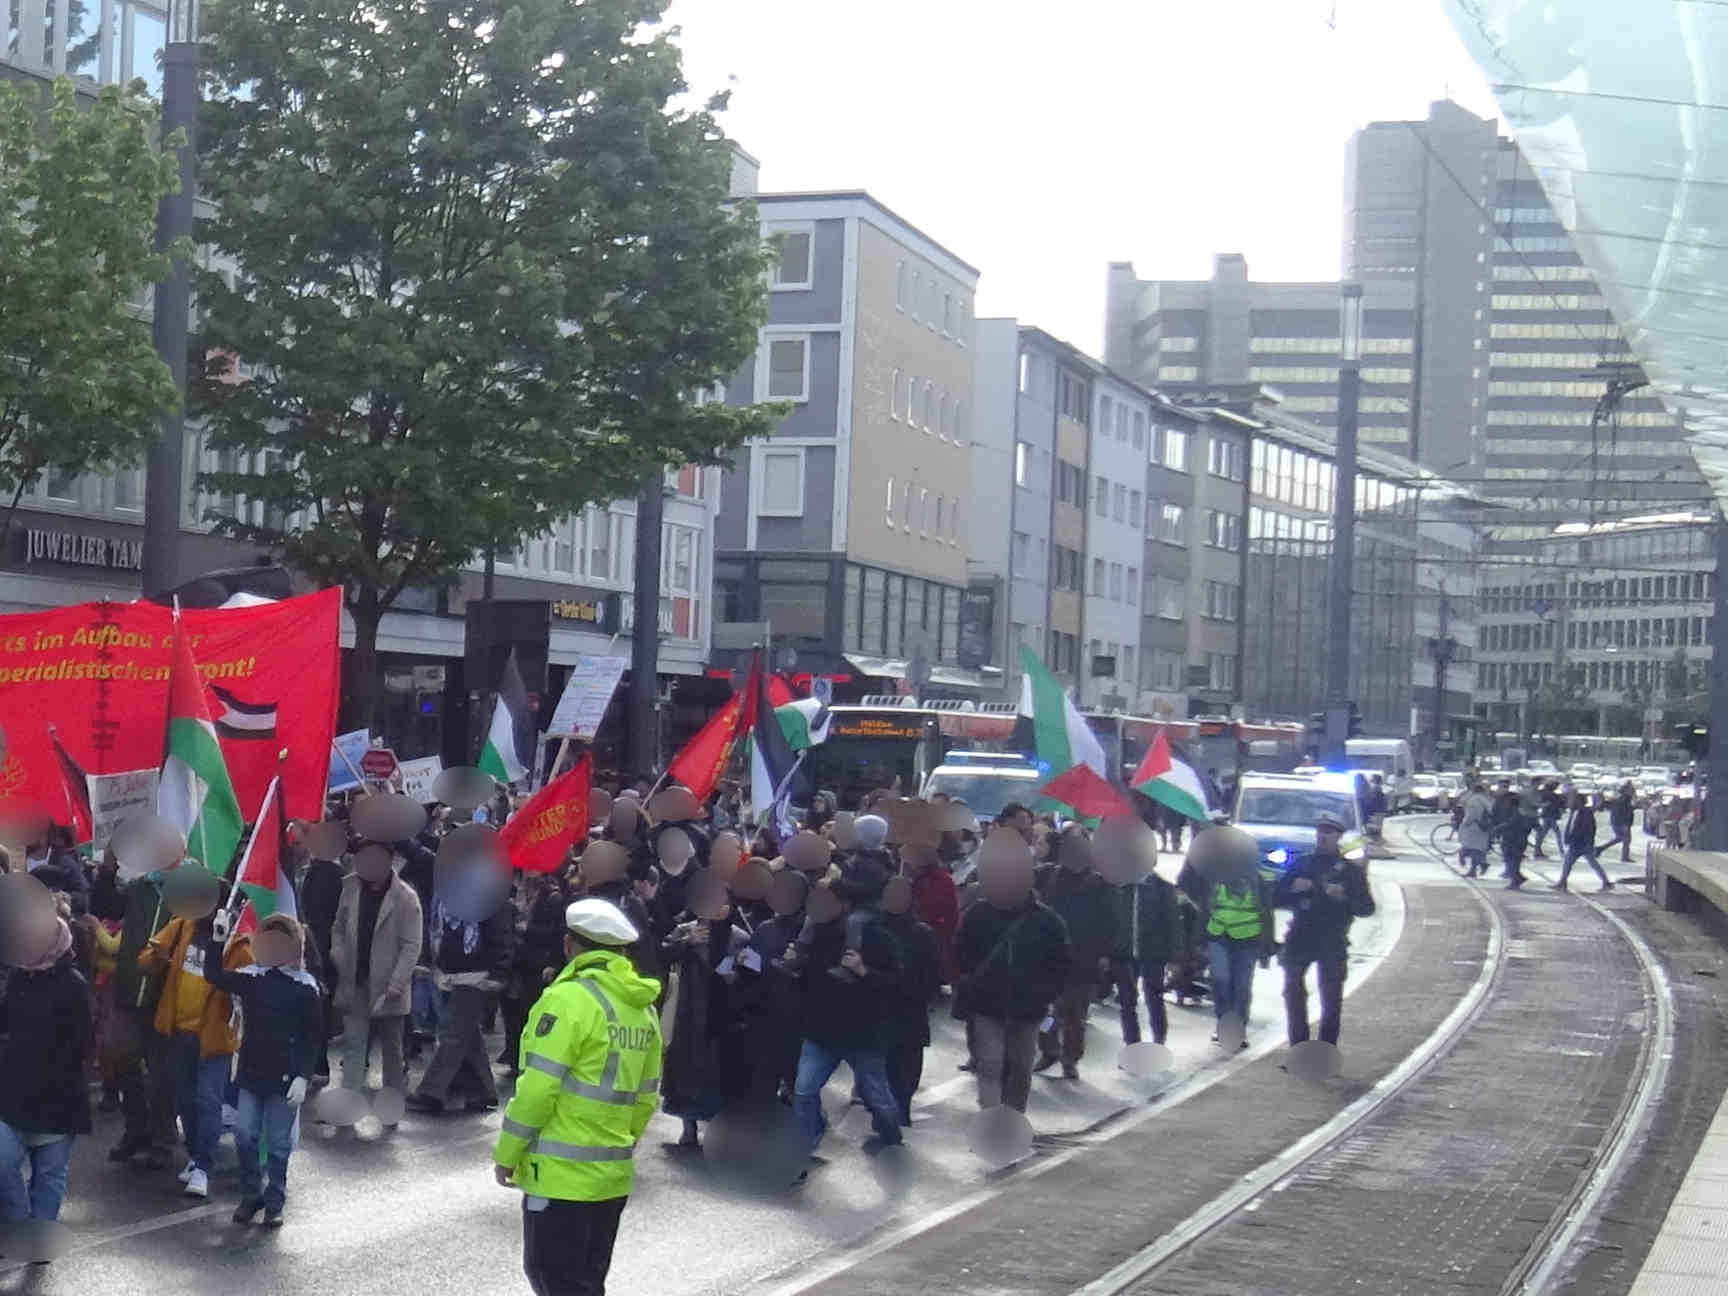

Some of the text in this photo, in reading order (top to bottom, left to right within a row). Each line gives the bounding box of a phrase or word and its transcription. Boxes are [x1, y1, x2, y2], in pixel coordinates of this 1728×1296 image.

[26, 528, 107, 567] JUWELIER
[33, 632, 64, 651] im
[70, 625, 153, 651] Aufbau
[160, 632, 201, 650] dr
[193, 657, 257, 680] ront!
